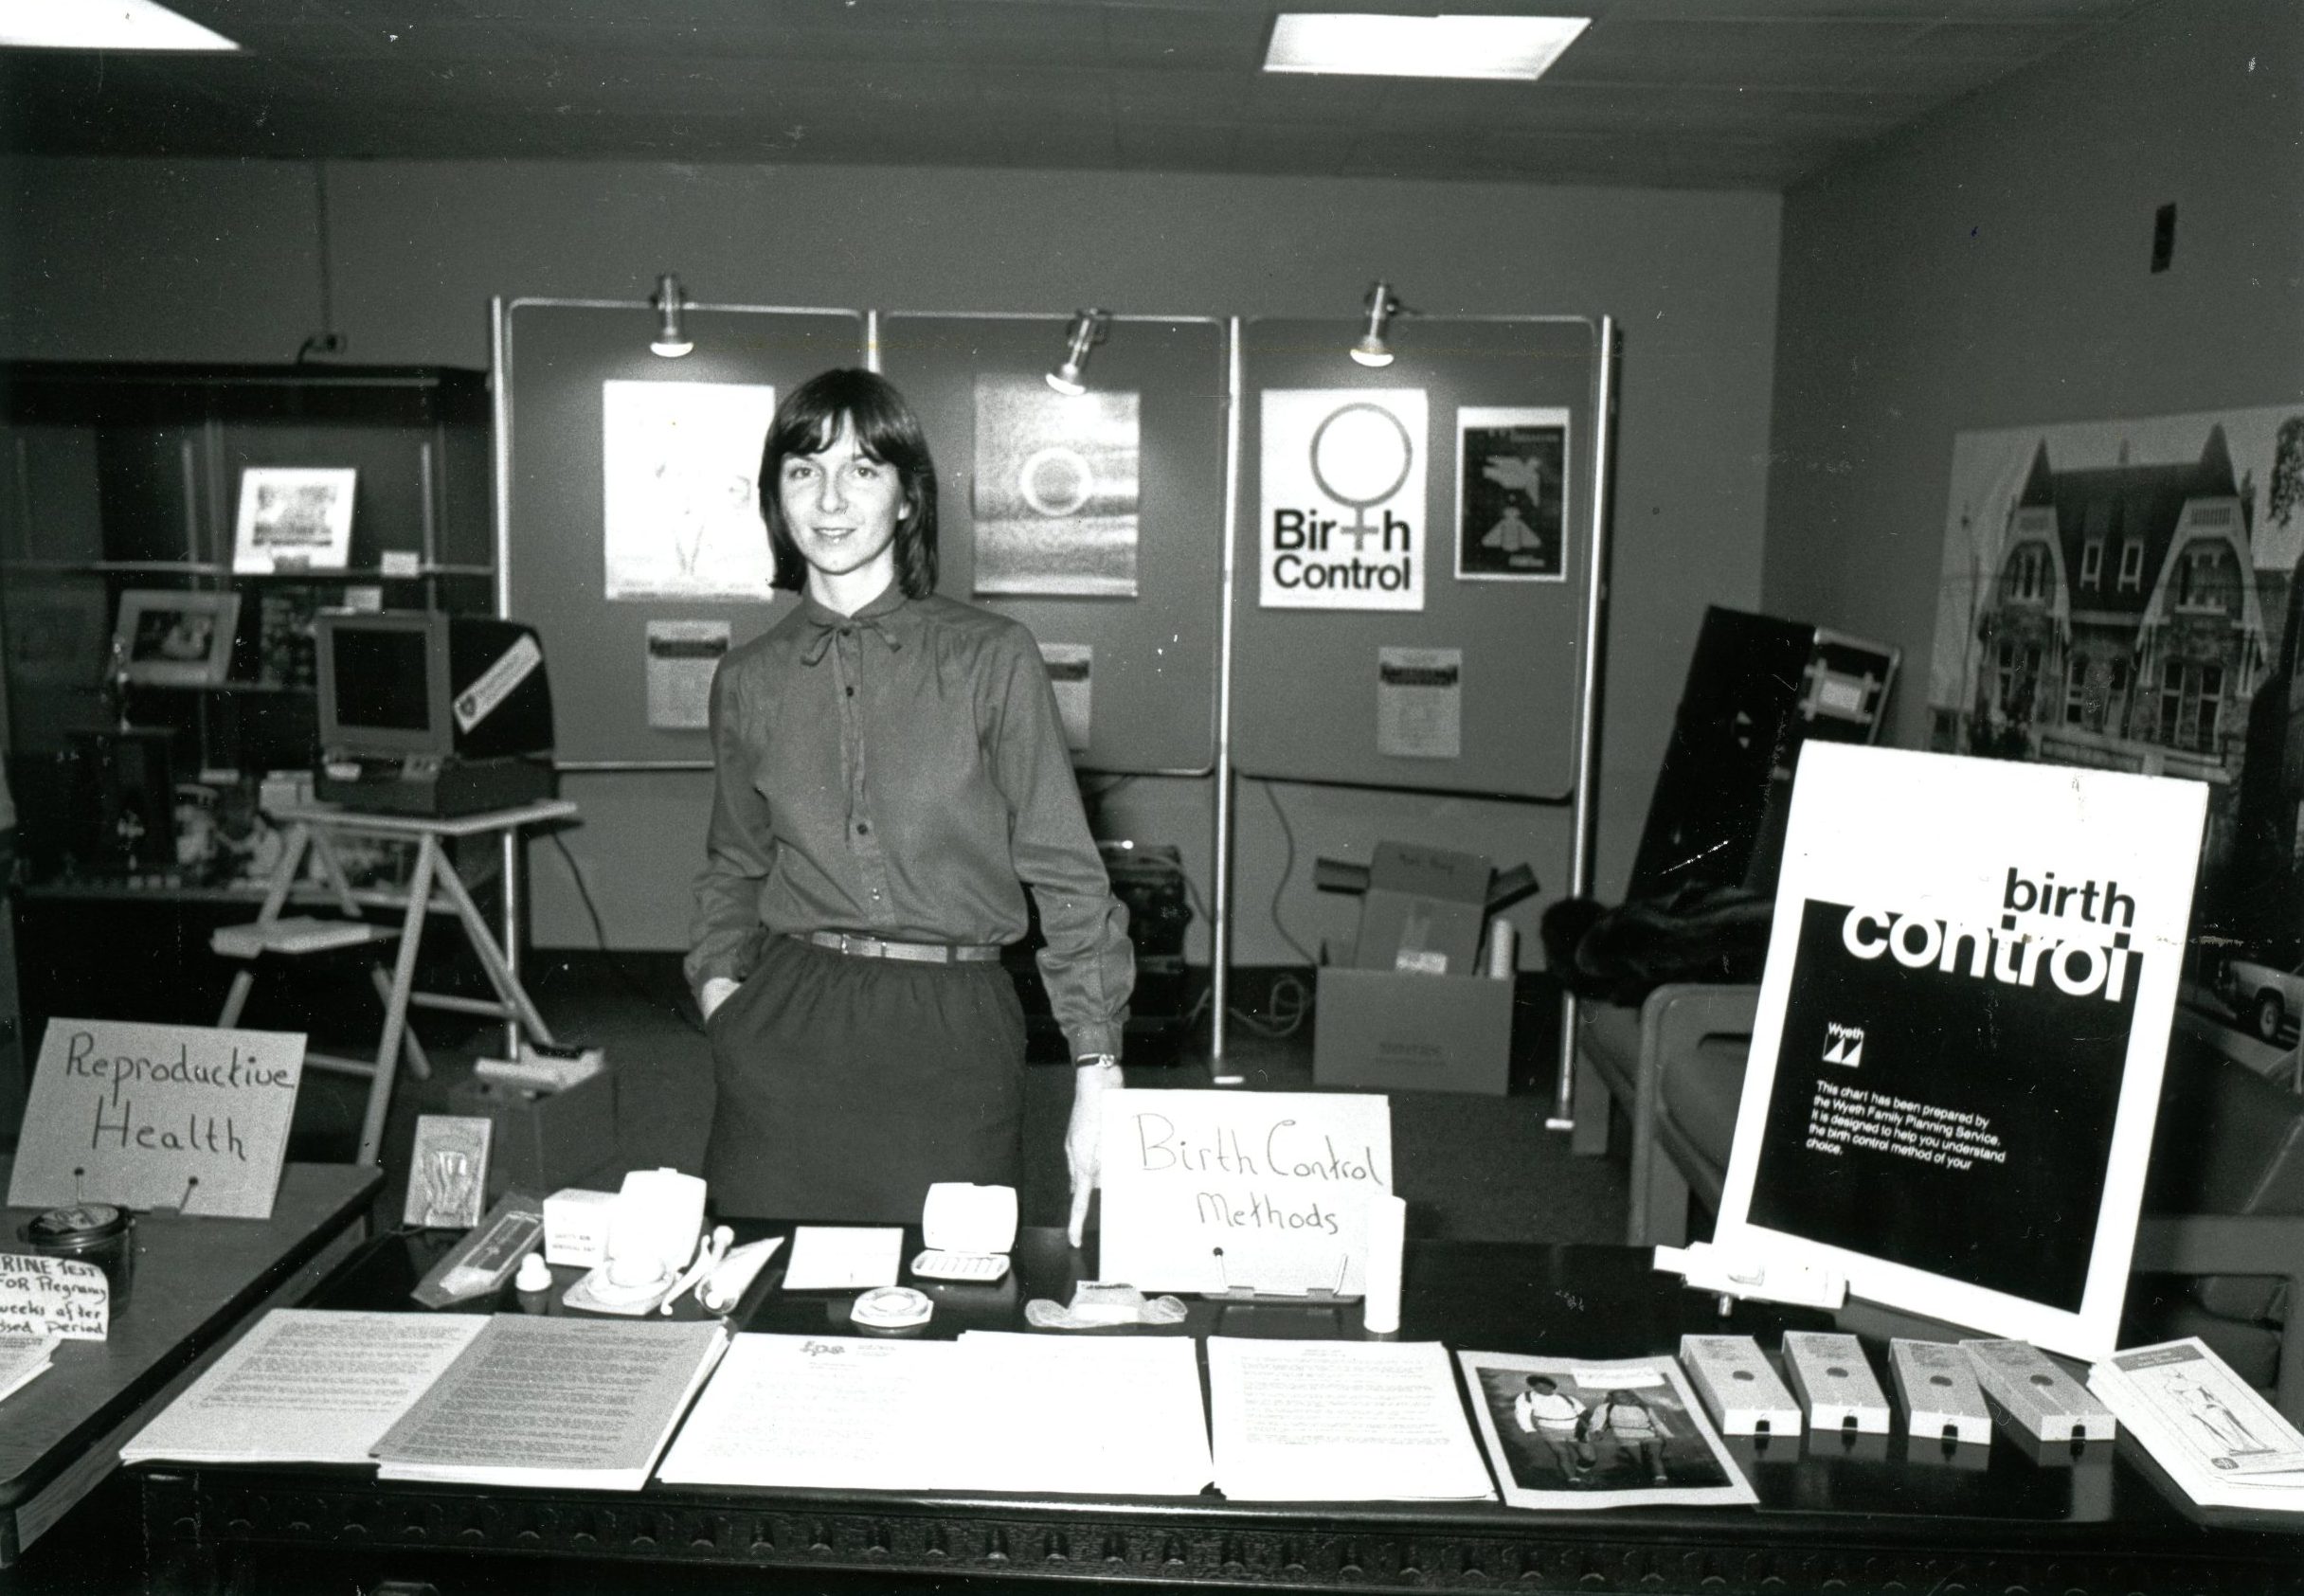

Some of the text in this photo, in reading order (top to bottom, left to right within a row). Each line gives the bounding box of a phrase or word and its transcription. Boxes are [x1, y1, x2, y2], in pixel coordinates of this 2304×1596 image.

[1272, 555, 1411, 591] Control
[2003, 867, 2135, 928] birth
[1842, 905, 2131, 1002] control
[1827, 1022, 1864, 1040] Wyeth
[66, 1031, 296, 1107] Reproductive
[92, 1095, 246, 1161] Health
[1814, 1095, 1829, 1108] the
[1832, 1098, 1865, 1116] Wyeth
[1867, 1106, 1903, 1126] Family
[1905, 1115, 1953, 1138] Planning
[1817, 1080, 1989, 1129] This chart has been prepared by
[1133, 1113, 1384, 1185] Birth Control
[1809, 1122, 1972, 1170] the birth control method of your
[1820, 1111, 1828, 1122] is
[1831, 1114, 1880, 1134] designed
[1881, 1123, 1892, 1136] to
[1894, 1126, 1917, 1142] help
[1919, 1135, 1939, 1148] you
[1943, 1139, 2007, 1163] understand
[1197, 1192, 1339, 1235] Methods
[56, 1301, 100, 1320] after
